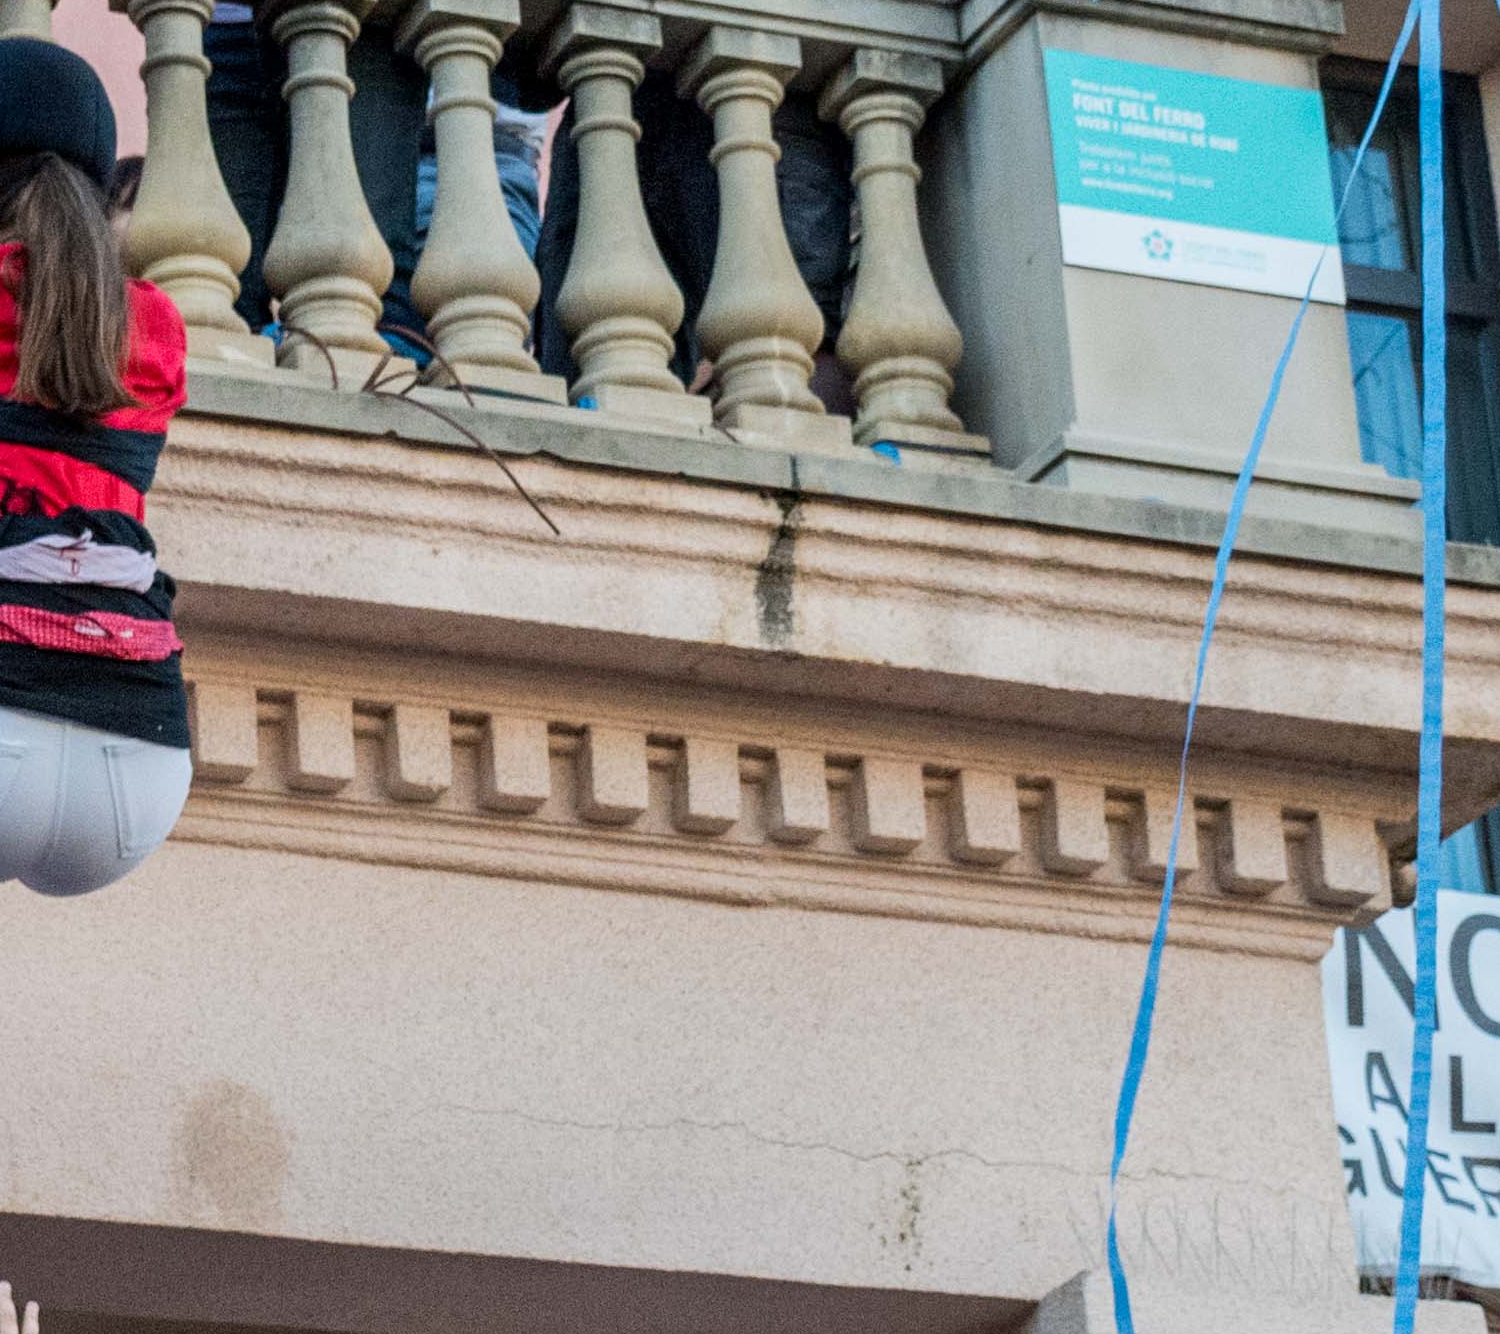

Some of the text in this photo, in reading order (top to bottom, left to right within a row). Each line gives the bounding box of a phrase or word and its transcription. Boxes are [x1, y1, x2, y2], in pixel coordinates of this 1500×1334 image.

[1072, 93, 1204, 129] FONT DEL FERRO
[1365, 1050, 1412, 1123] A
